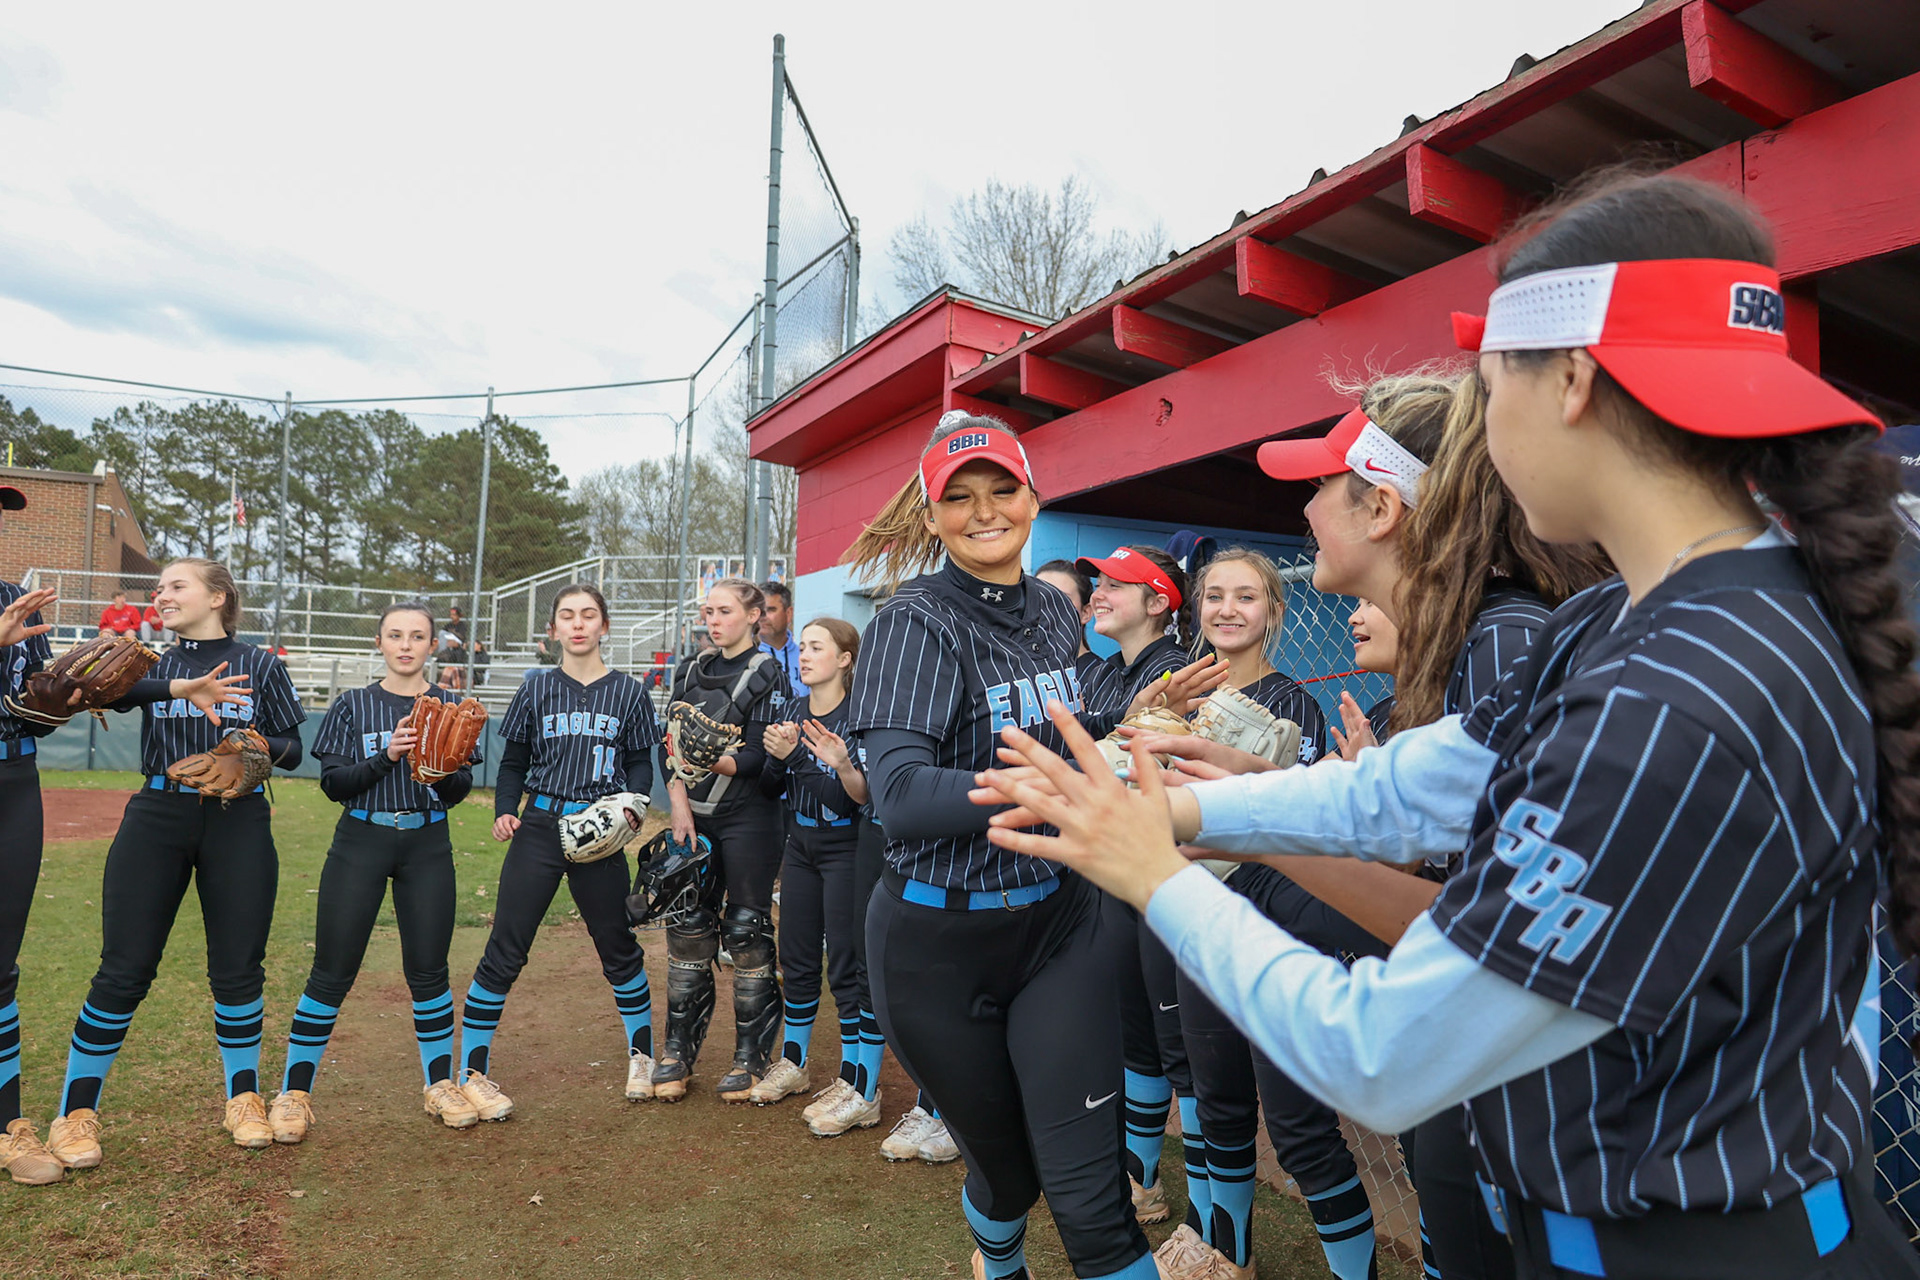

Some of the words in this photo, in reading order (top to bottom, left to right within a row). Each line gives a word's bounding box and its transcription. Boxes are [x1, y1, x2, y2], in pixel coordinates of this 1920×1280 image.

[543, 712, 620, 740] EAGLES
[593, 744, 615, 782] 14
[1492, 797, 1613, 966] SBA
